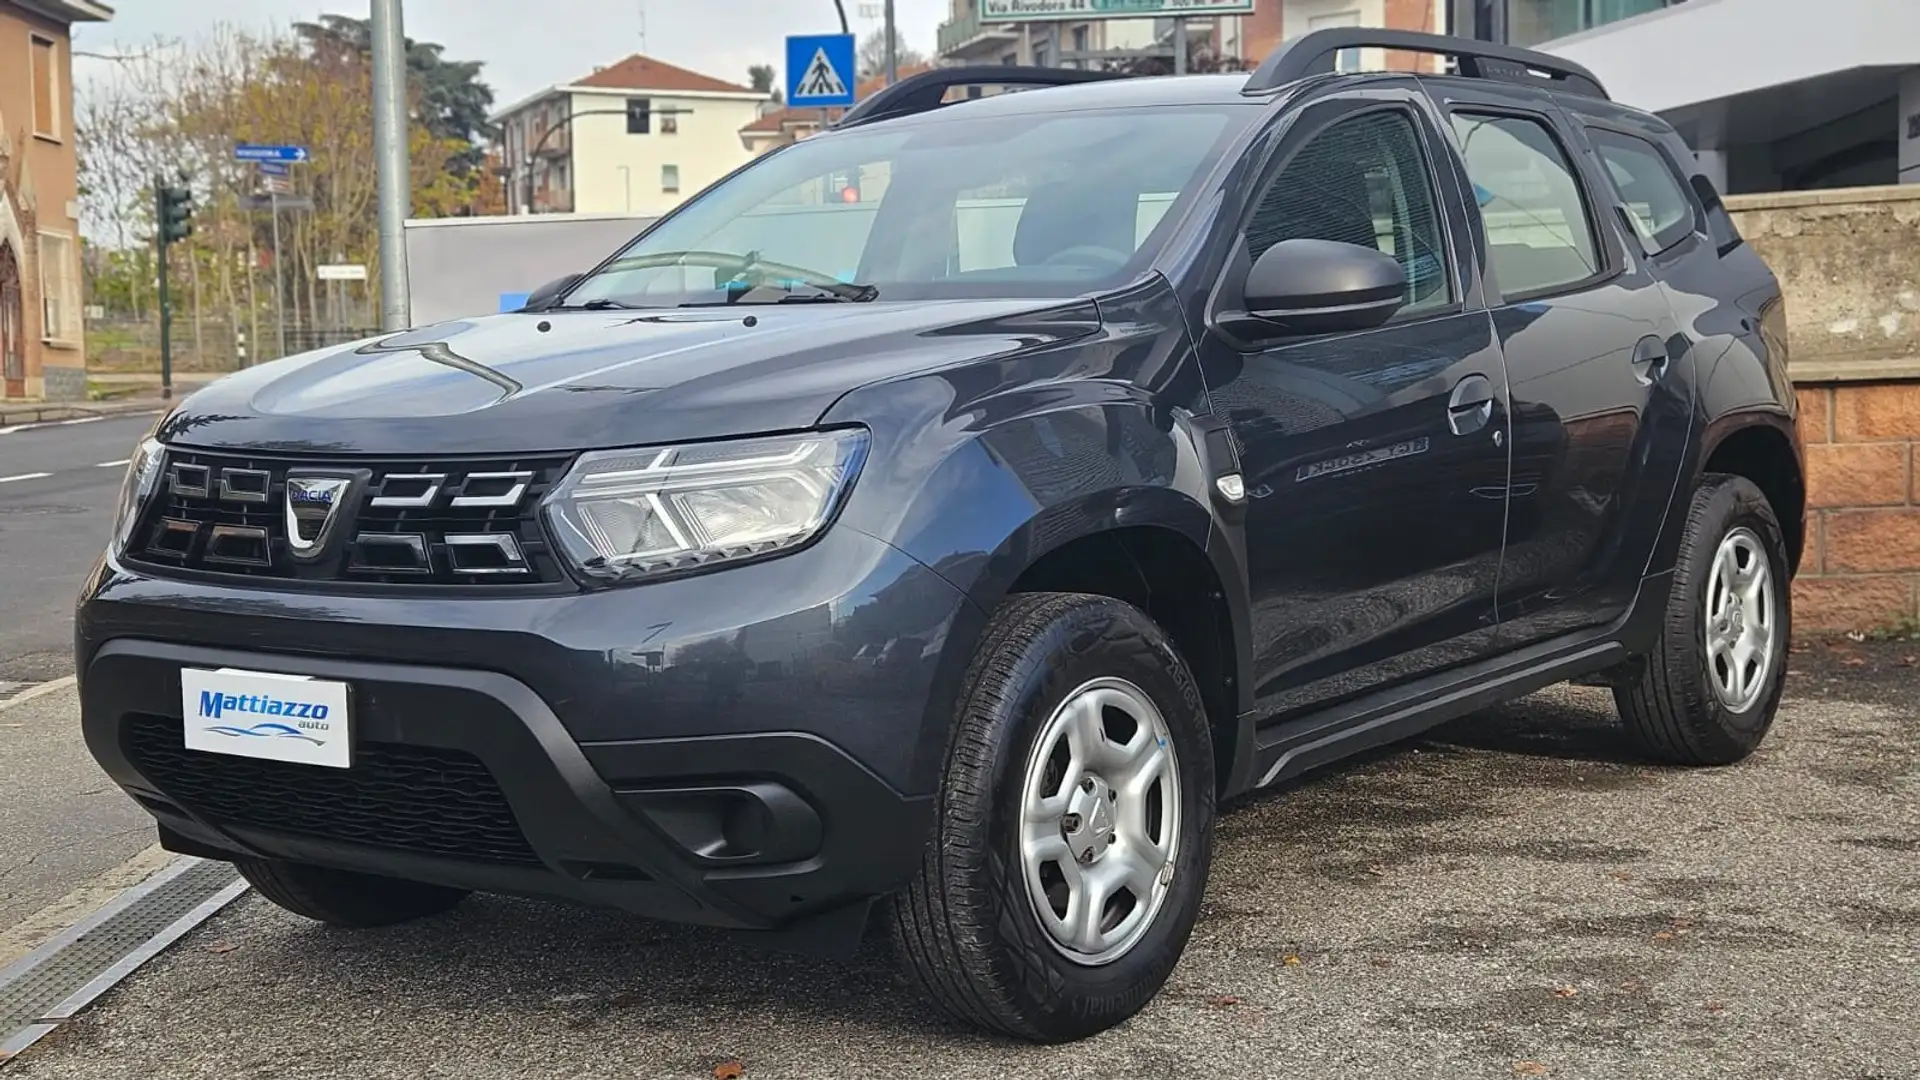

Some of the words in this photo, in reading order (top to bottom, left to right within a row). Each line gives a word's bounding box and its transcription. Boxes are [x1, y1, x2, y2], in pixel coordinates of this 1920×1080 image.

[987, 0, 1008, 12] Via
[291, 490, 333, 503] DACIA
[199, 690, 329, 720] Mattiazzo
[298, 720, 330, 731] auto
